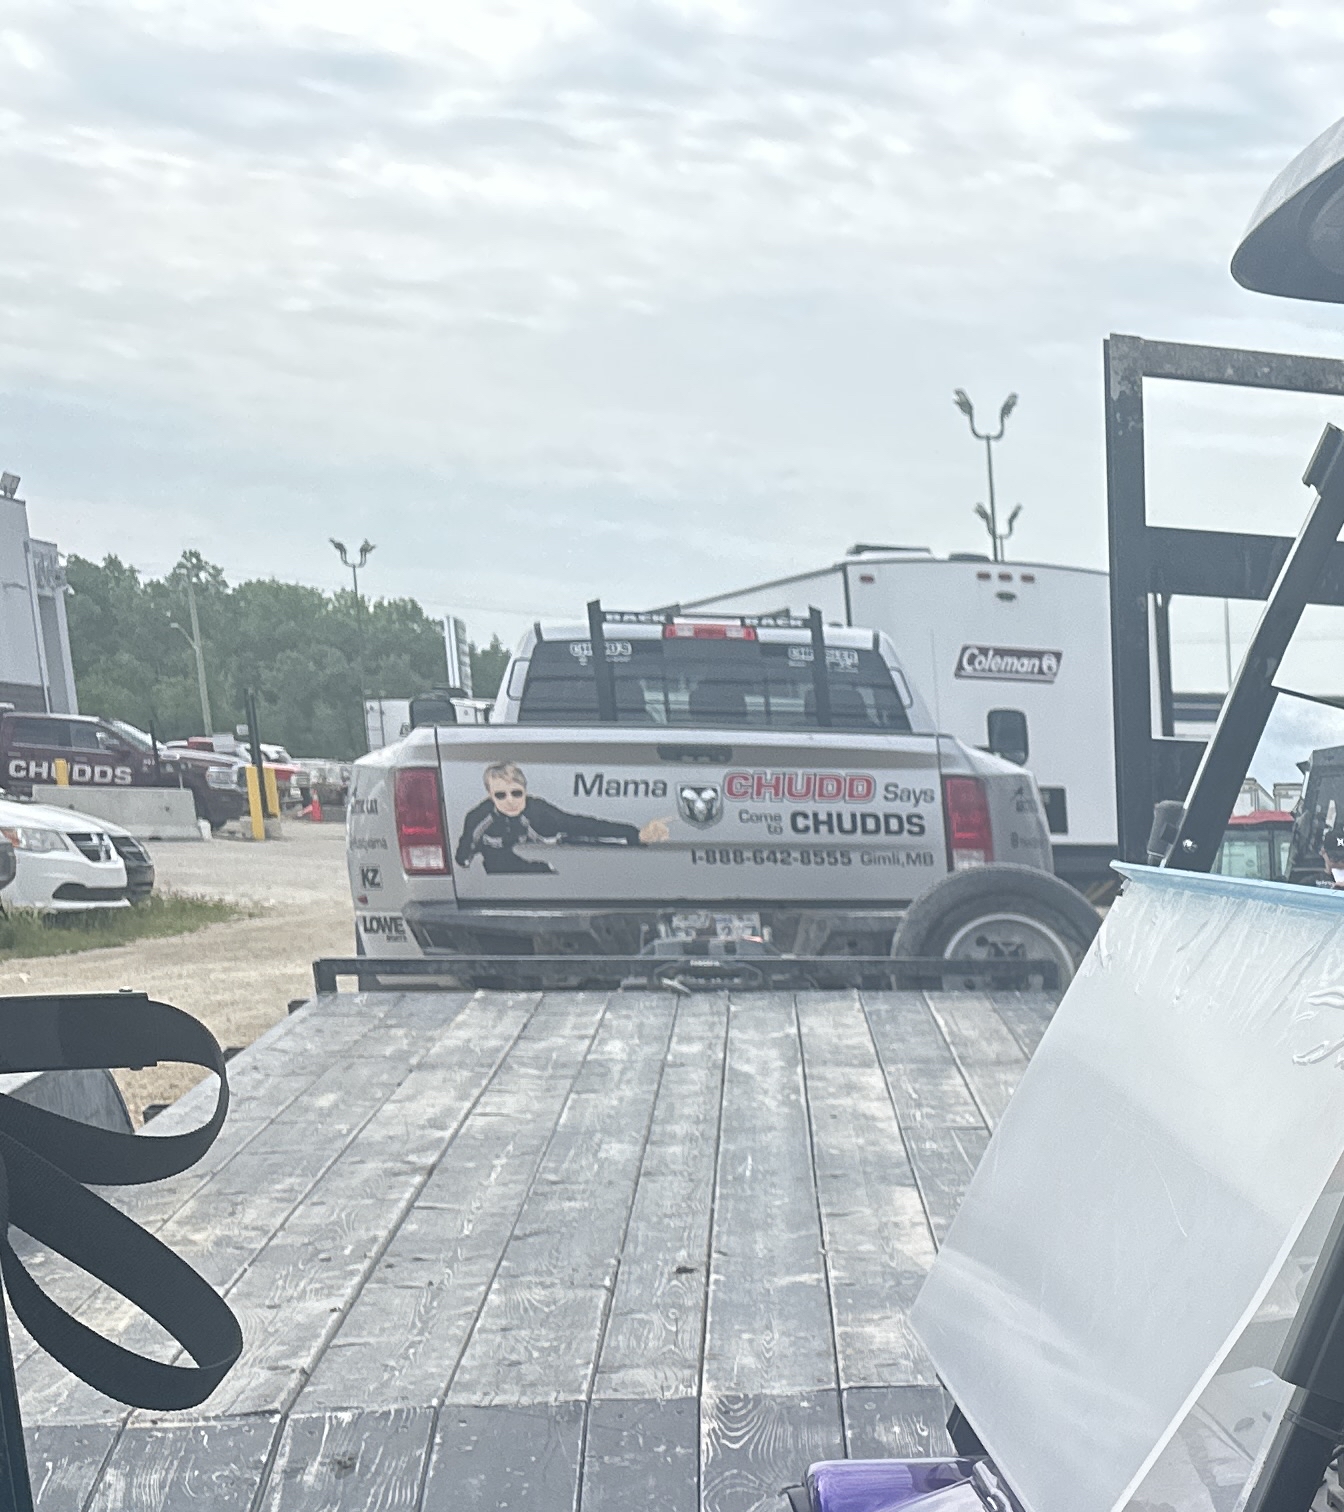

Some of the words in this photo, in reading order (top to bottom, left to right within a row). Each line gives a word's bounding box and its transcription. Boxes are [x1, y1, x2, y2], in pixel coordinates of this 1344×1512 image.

[962, 646, 1041, 674] Coleman
[573, 771, 668, 798] Mama
[723, 770, 877, 804] CHUDD
[883, 782, 935, 808] Says
[738, 809, 782, 824] Come
[767, 822, 783, 835] to
[790, 810, 926, 837] CHUDDS
[691, 849, 852, 866] 1-888-642-8555
[361, 868, 381, 888] KZ
[363, 915, 406, 935] LOWE
